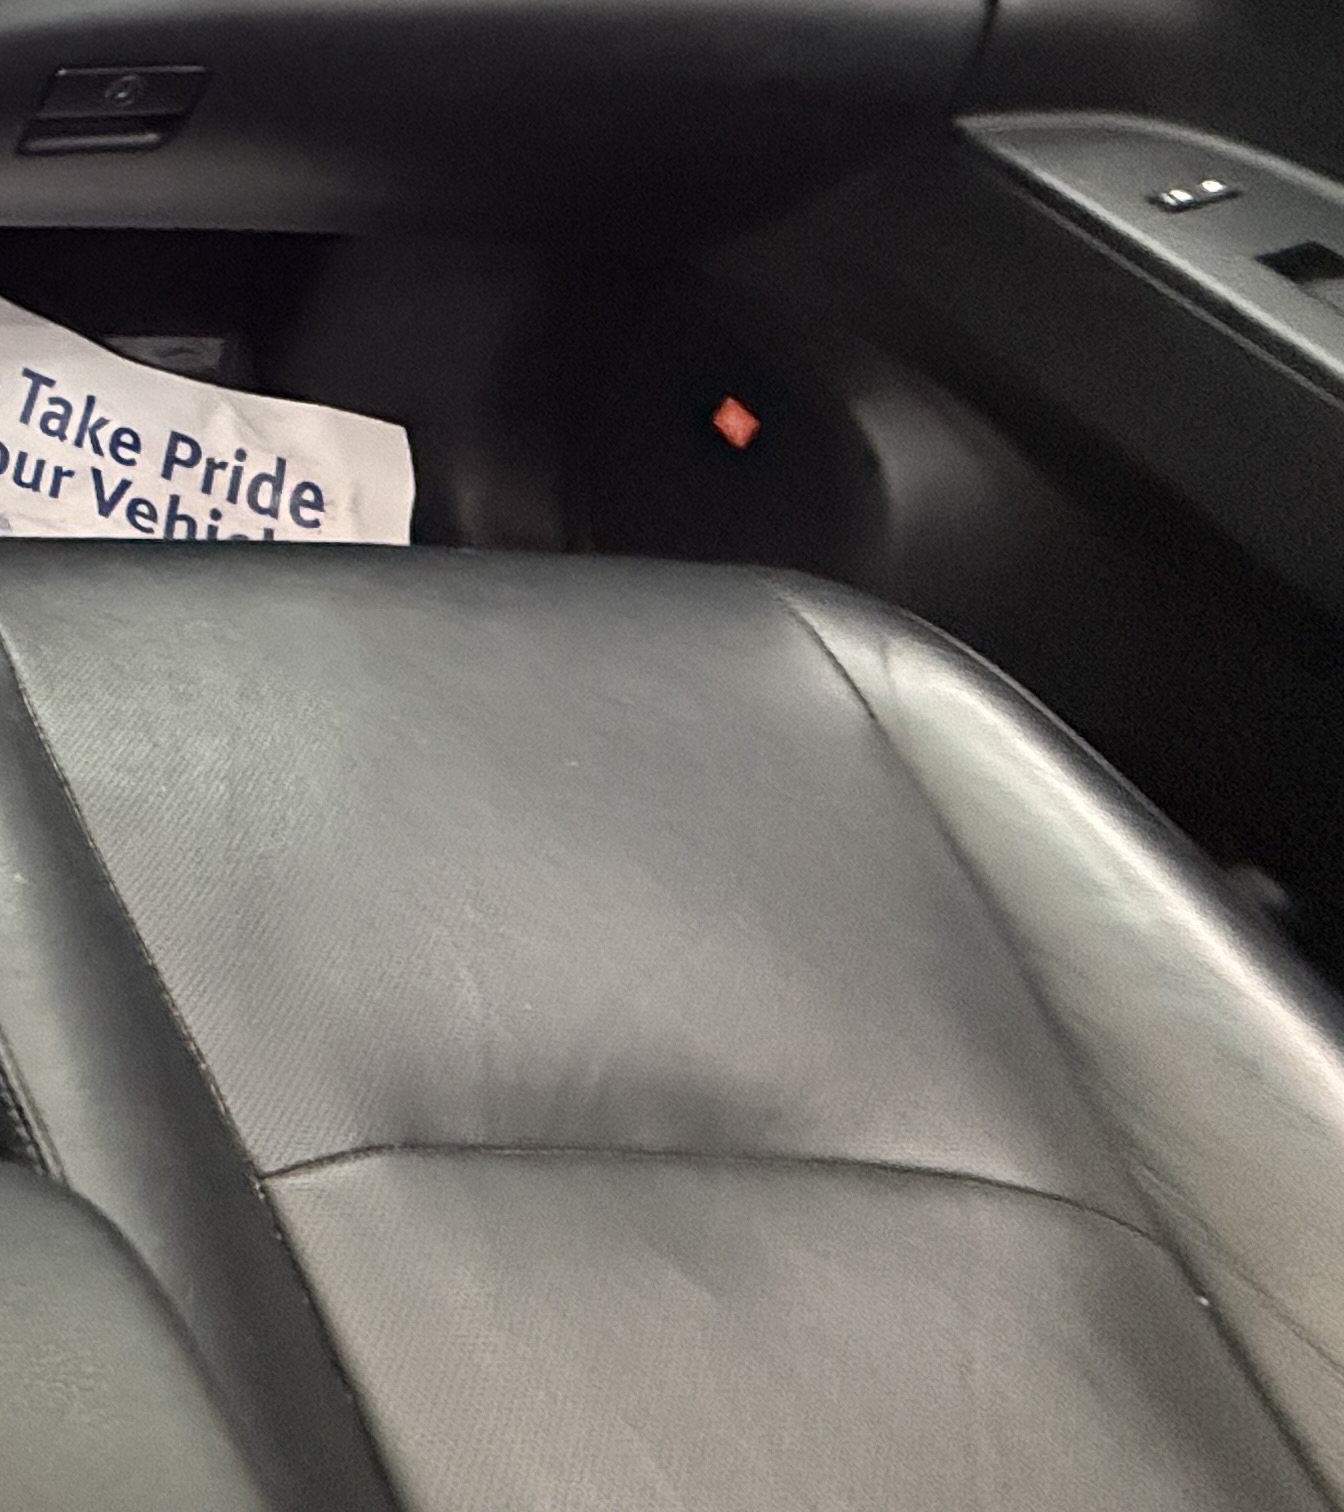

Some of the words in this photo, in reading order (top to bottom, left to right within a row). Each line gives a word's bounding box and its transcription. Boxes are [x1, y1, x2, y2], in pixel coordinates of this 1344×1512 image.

[17, 366, 143, 468] Take
[160, 429, 326, 530] Pride
[90, 465, 275, 542] Vehi
